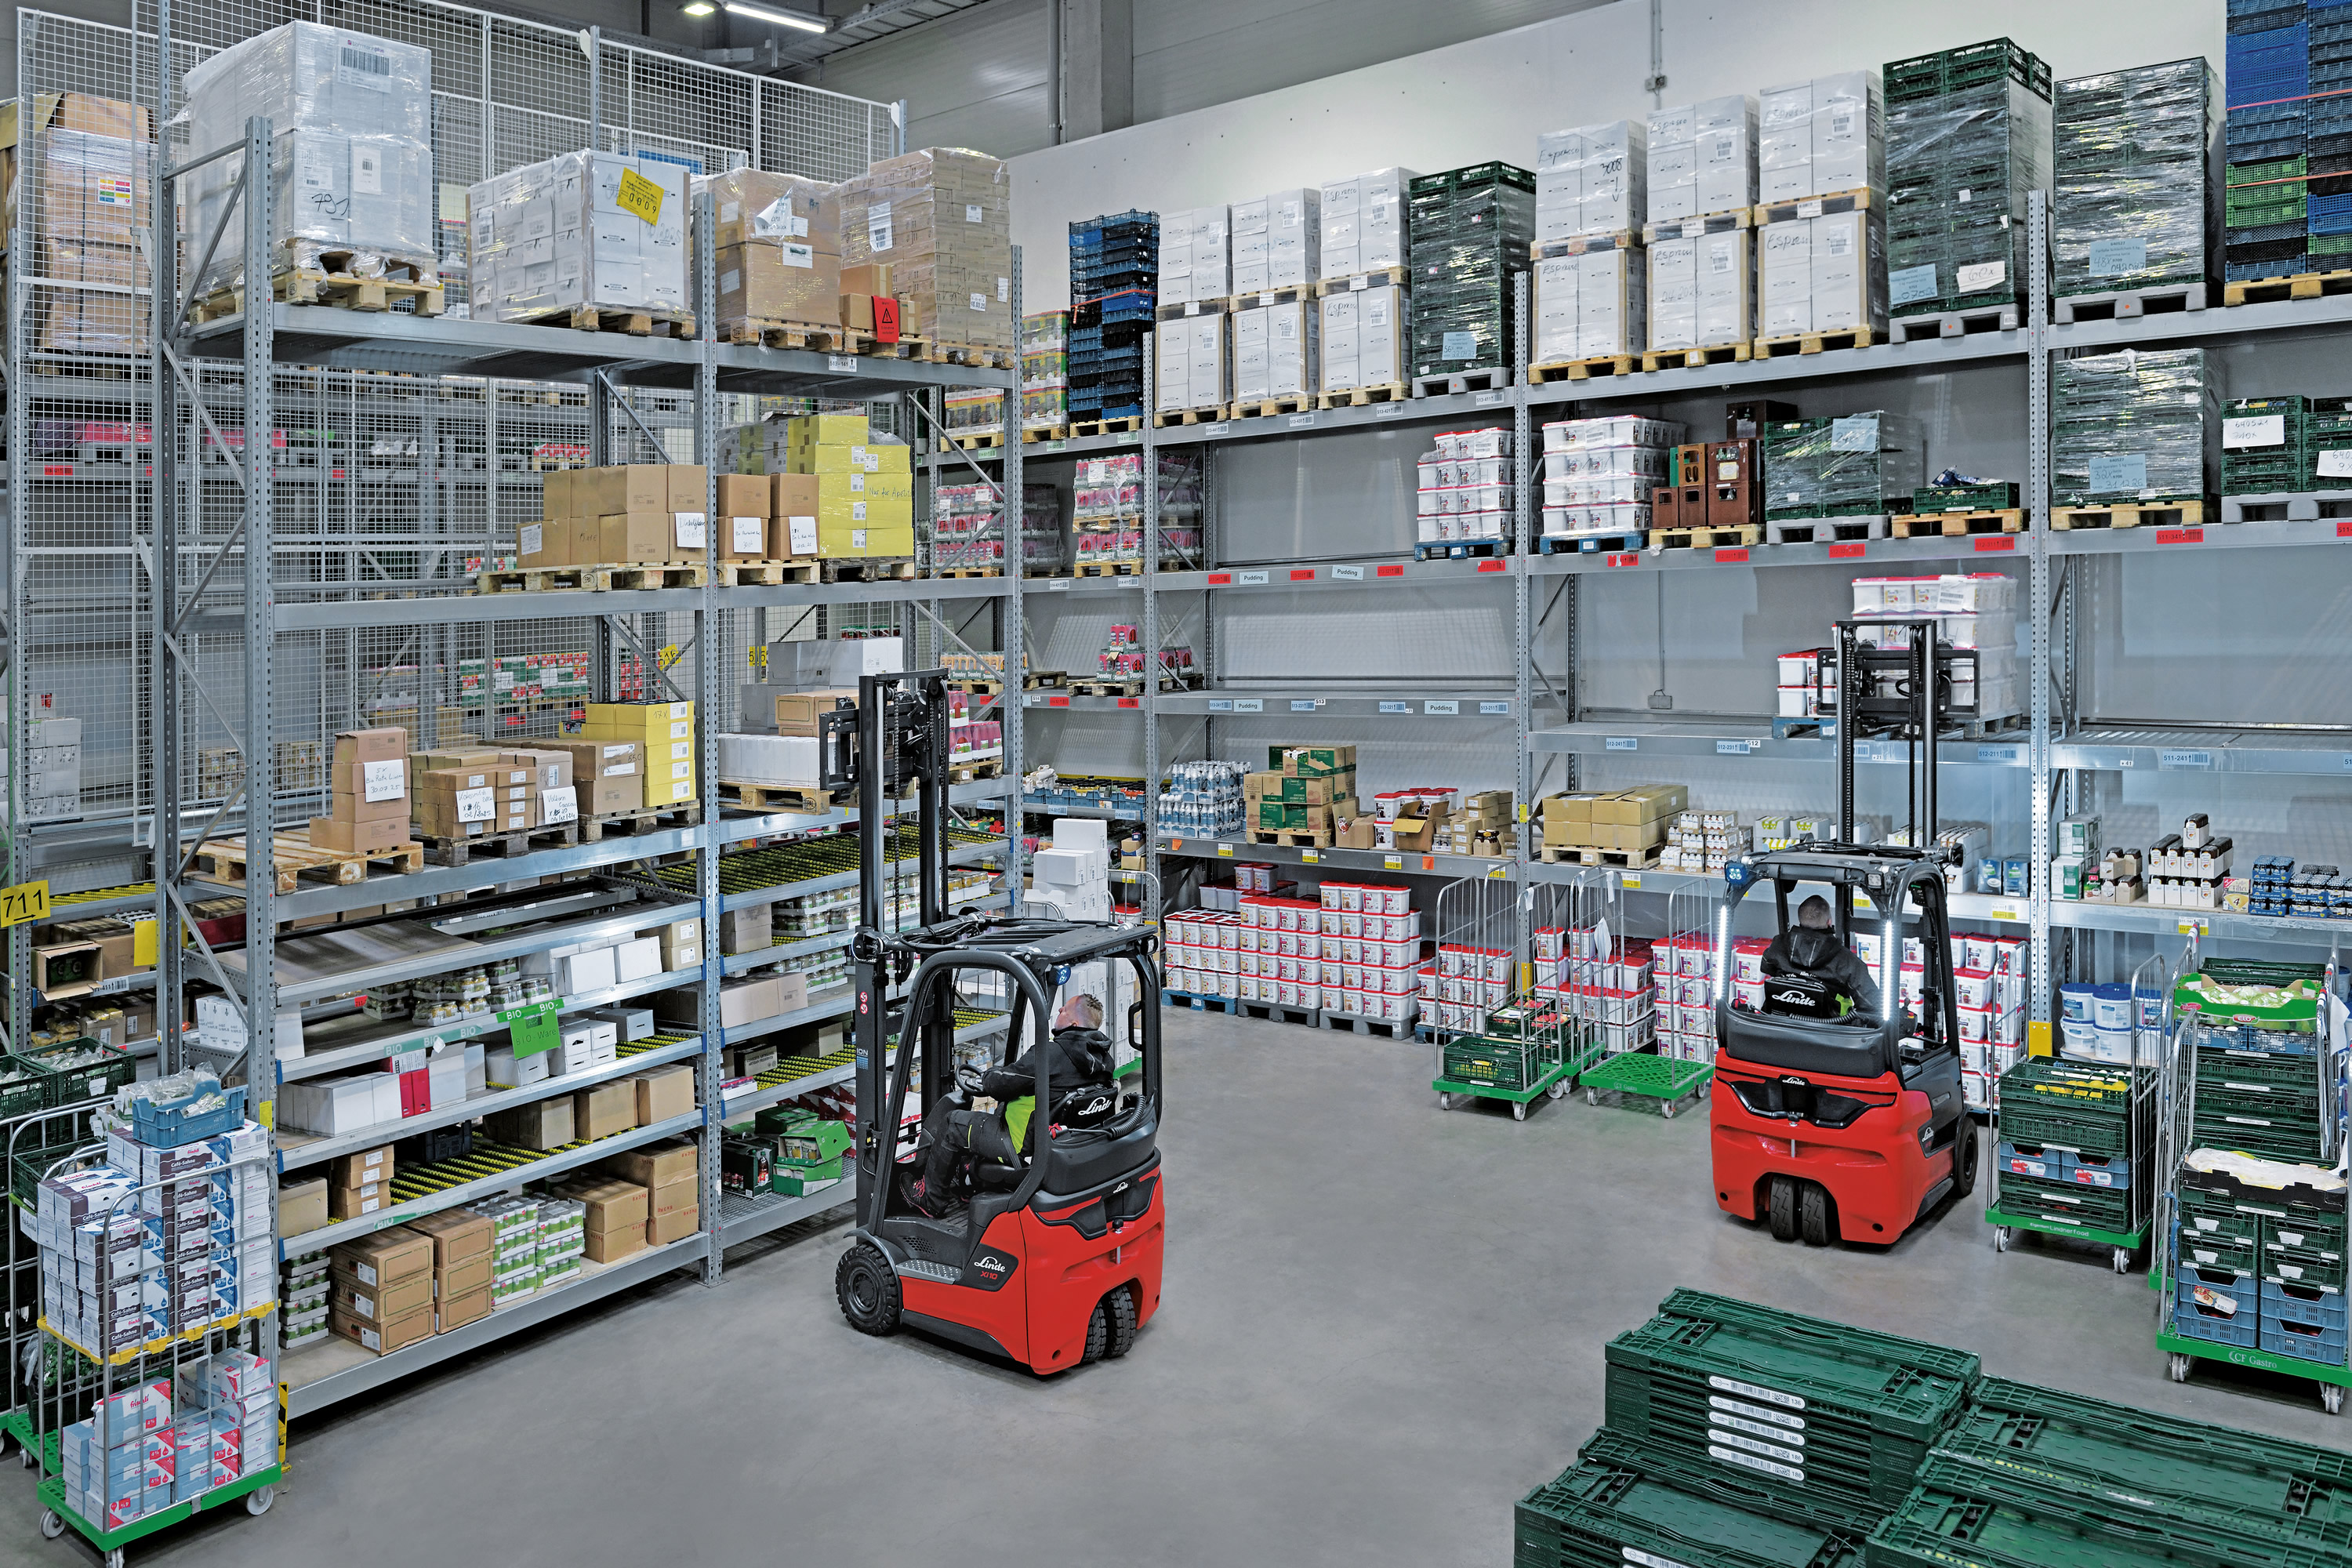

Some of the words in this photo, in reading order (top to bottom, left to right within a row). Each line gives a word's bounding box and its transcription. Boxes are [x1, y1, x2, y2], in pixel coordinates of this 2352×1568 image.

[1337, 568, 1358, 578] Pudding
[1429, 704, 1454, 713] Pudding
[3, 889, 42, 918] 711
[2233, 898, 2240, 906] 4
[1772, 990, 1816, 1007] Linde
[506, 1010, 522, 1021] BIO
[539, 1001, 555, 1012] BIO
[537, 1028, 557, 1039] Ware
[385, 1044, 402, 1055] BIO
[460, 1027, 476, 1037] BIO
[1782, 1076, 1806, 1085] Linde
[217, 1142, 226, 1151] 240
[171, 1158, 196, 1168] Café-Sahne
[1113, 1181, 1129, 1193] Linde
[2049, 1225, 2073, 1234] Lindner
[974, 1256, 1006, 1272] Linde
[980, 1271, 998, 1279] Xi10
[181, 1276, 205, 1287] Café-Sahne
[111, 1306, 137, 1317] Café-Sahne
[180, 1306, 205, 1317] Café-Sahne
[111, 1329, 137, 1341] Café-Sahne
[2249, 1356, 2278, 1369] Gastro
[146, 1419, 156, 1428] 4%
[151, 1450, 161, 1458] 4%
[150, 1476, 160, 1485] 4%
